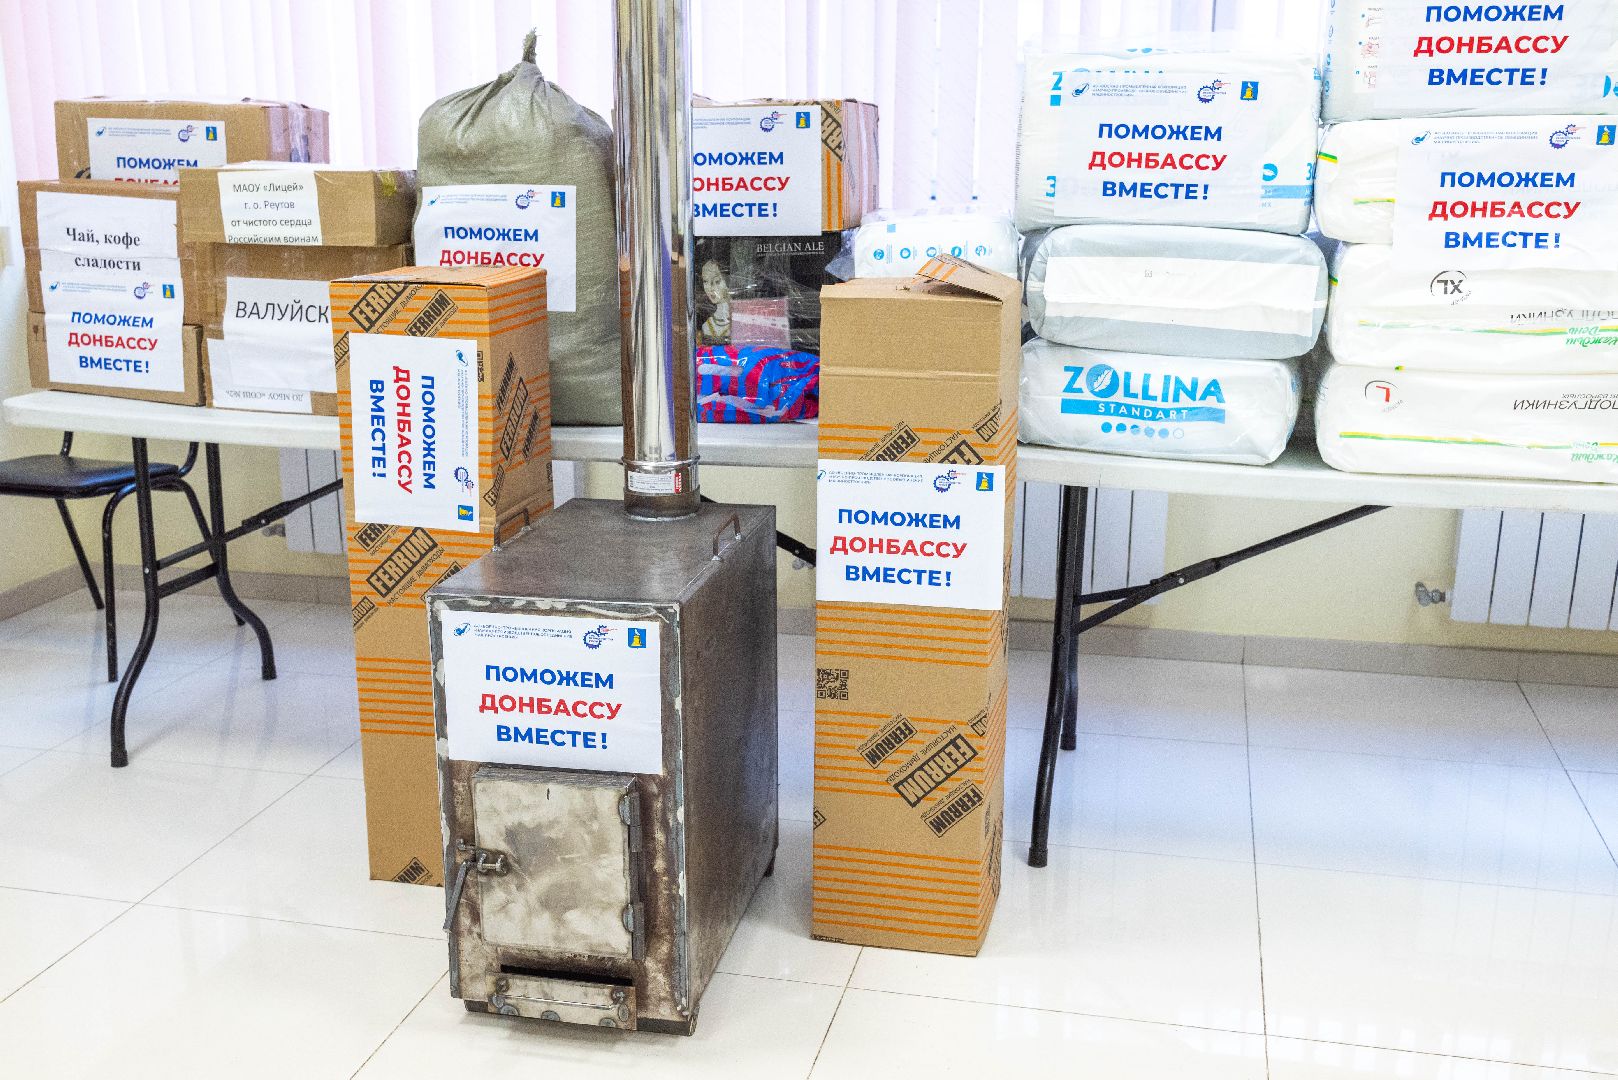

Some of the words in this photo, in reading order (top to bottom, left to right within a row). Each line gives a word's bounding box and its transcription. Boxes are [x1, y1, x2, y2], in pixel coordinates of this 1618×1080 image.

[1425, 5, 1564, 22] ПОМОЖЕМ
[1413, 36, 1569, 57] ДОНБАССУ
[1427, 68, 1548, 86] ВМЕСТЕ!
[1098, 123, 1222, 141] ПОМОЖЕМ
[693, 151, 784, 166] ОМОЖЕМ
[1088, 151, 1227, 170] ДОНБАССУ
[233, 184, 261, 192] МАОУ
[264, 183, 304, 193] «Лицей»
[693, 176, 790, 192] ОНБАССУ
[1439, 172, 1576, 188] ПОМОЖЕМ
[1102, 181, 1209, 200] ВМЕСТЕ!
[264, 201, 295, 211] Реутов
[1428, 201, 1581, 221] ДОНБАССУ
[243, 219, 278, 227] чистого
[280, 219, 312, 228] сердца
[66, 227, 100, 245] Чай,
[104, 232, 141, 249] кофе
[284, 235, 319, 243] воинам
[443, 227, 539, 242] ПОМОЖЕМ
[1444, 232, 1560, 249] ВМЕСТЕ!
[757, 242, 802, 253] BELGIAN
[806, 241, 825, 251] ALE
[75, 256, 141, 271] сладости
[440, 250, 545, 267] ДОНБАССУ
[1437, 279, 1463, 295] XL
[71, 312, 154, 328] ПОМОЖЕМ
[235, 299, 329, 324] ВАЛУЙСК
[407, 293, 452, 336] FERRUM
[68, 333, 158, 351] ДОНБАССУ
[79, 356, 149, 373] ВМЕСТЕ!
[1062, 363, 1226, 404] ZOLLINA
[1376, 385, 1390, 402] L
[1098, 402, 1188, 421] STANDART
[369, 379, 386, 478] ВМЕСТЕ!
[393, 366, 412, 494] ДОНБАССУ
[421, 375, 436, 489] ПОМОЖЕМ
[838, 509, 960, 530] ПОМОЖЕМ
[830, 536, 967, 558] ДОНБАССУ
[368, 527, 434, 595] FERRUM
[845, 565, 951, 587] ВМЕСТЕ!
[485, 665, 614, 689] ПОМОЖЕМ
[479, 693, 622, 720] ДОНБАССУ
[496, 725, 607, 749] ВМЕСТЕ!
[864, 720, 914, 765] FERRUM
[897, 735, 974, 804] FERRUM
[928, 786, 983, 834] FERRUM
